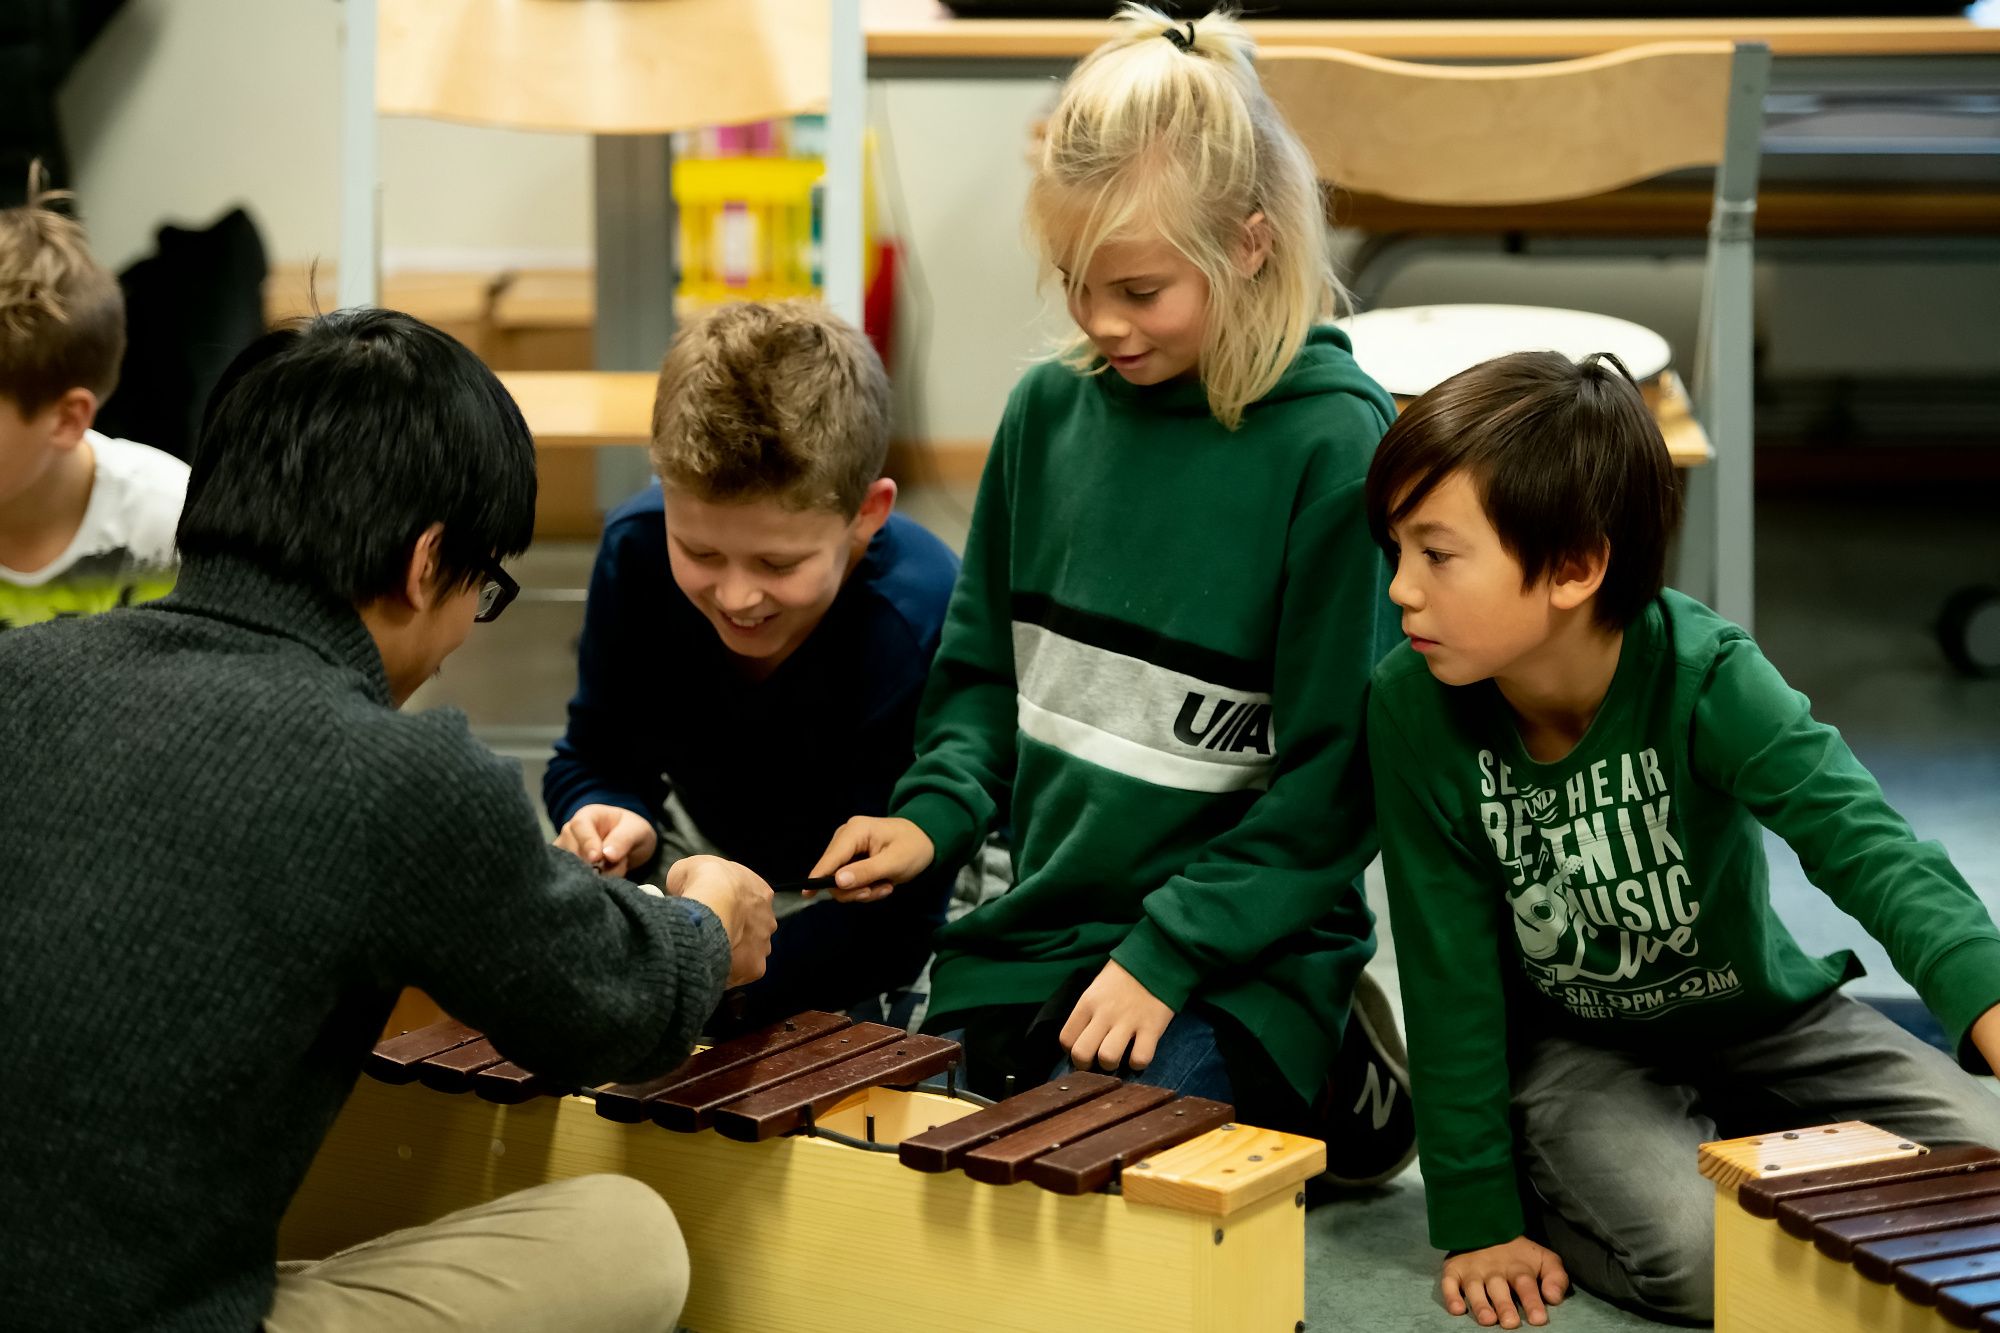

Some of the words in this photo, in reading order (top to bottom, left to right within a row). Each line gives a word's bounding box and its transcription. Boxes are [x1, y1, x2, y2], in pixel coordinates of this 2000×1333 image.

[1566, 747, 1667, 818] HEAR
[1558, 864, 1700, 932] MUSIC
[1353, 1060, 1397, 1130] N
